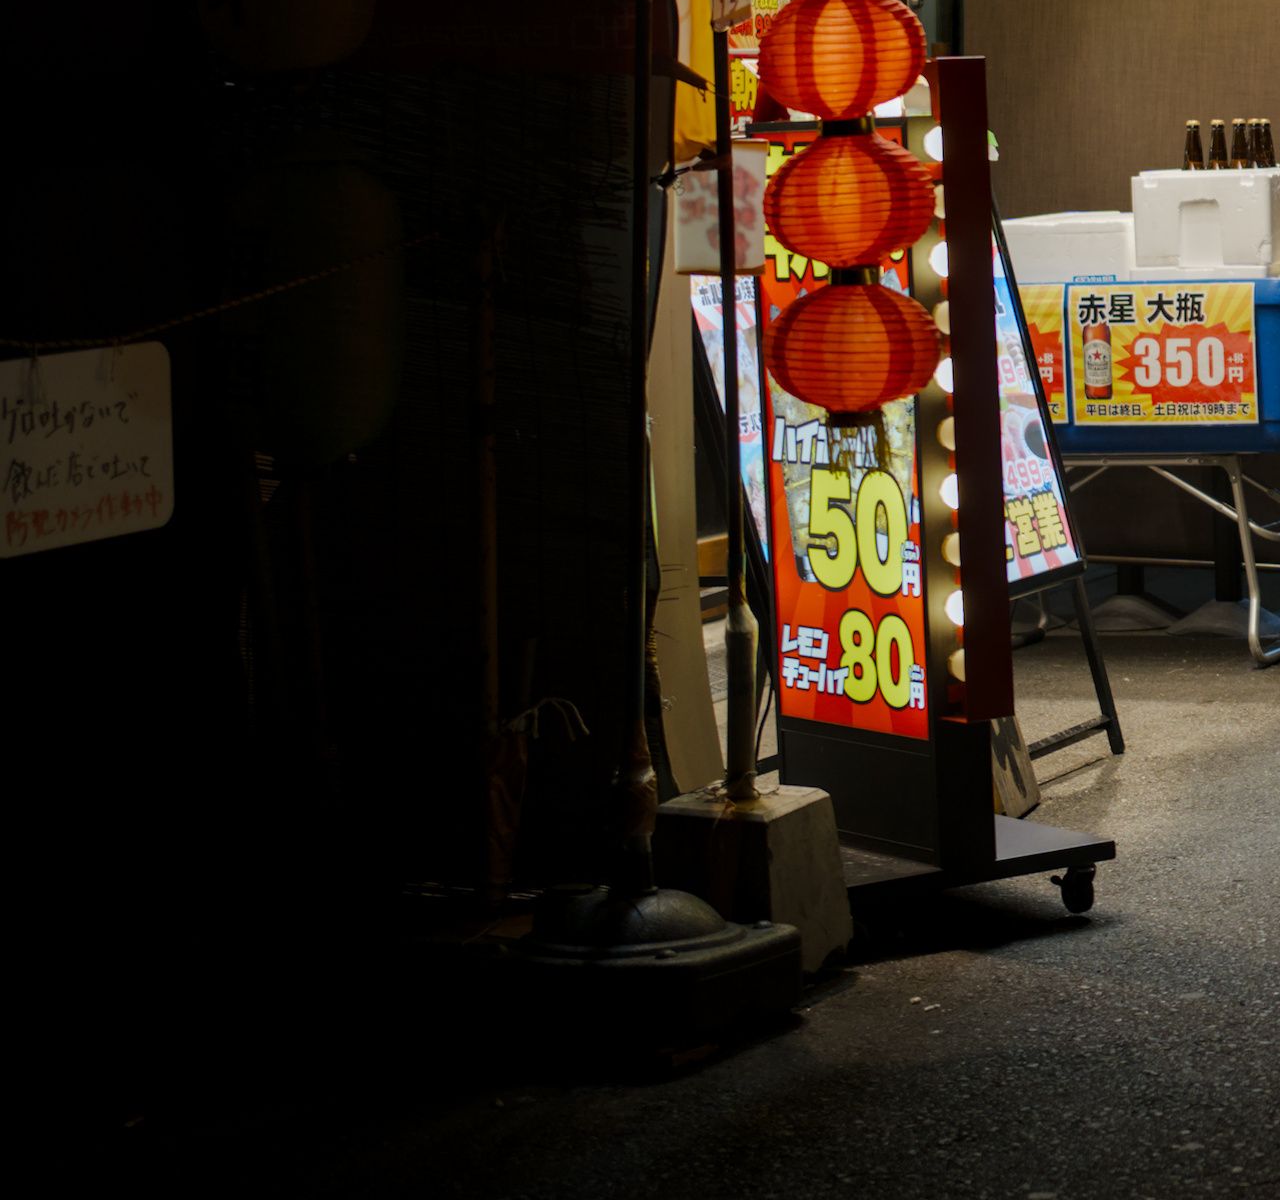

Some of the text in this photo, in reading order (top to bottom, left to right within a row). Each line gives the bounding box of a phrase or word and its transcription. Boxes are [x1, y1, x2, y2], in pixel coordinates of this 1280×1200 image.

[1077, 292, 1206, 324] 赤星 大瓶
[1133, 336, 1226, 388] 350
[839, 608, 915, 710] 80
